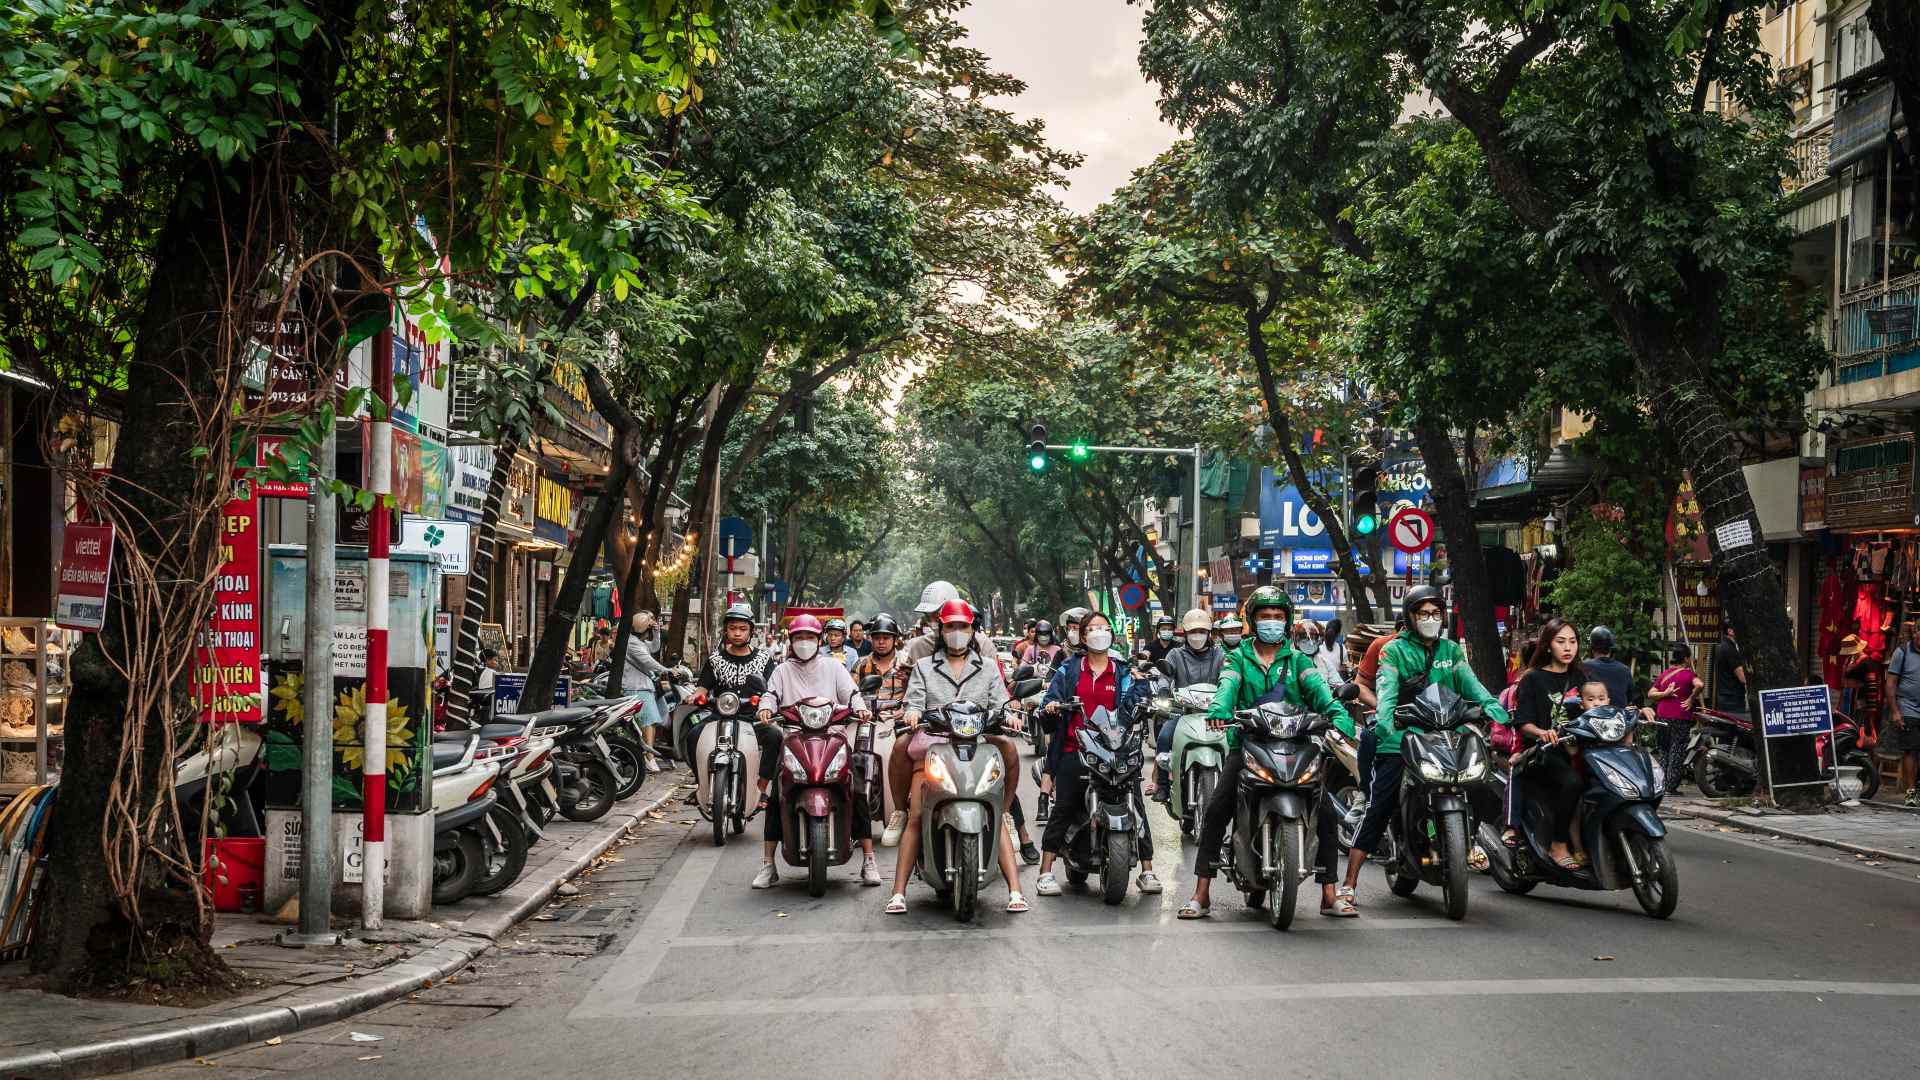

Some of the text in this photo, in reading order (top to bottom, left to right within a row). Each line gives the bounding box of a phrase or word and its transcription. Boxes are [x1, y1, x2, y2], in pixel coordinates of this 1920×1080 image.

[75, 538, 101, 556] viettel
[440, 553, 464, 563] VEL
[222, 600, 253, 620] KÍNH
[224, 631, 254, 652] THOẠI
[1765, 708, 1785, 727] CẤM
